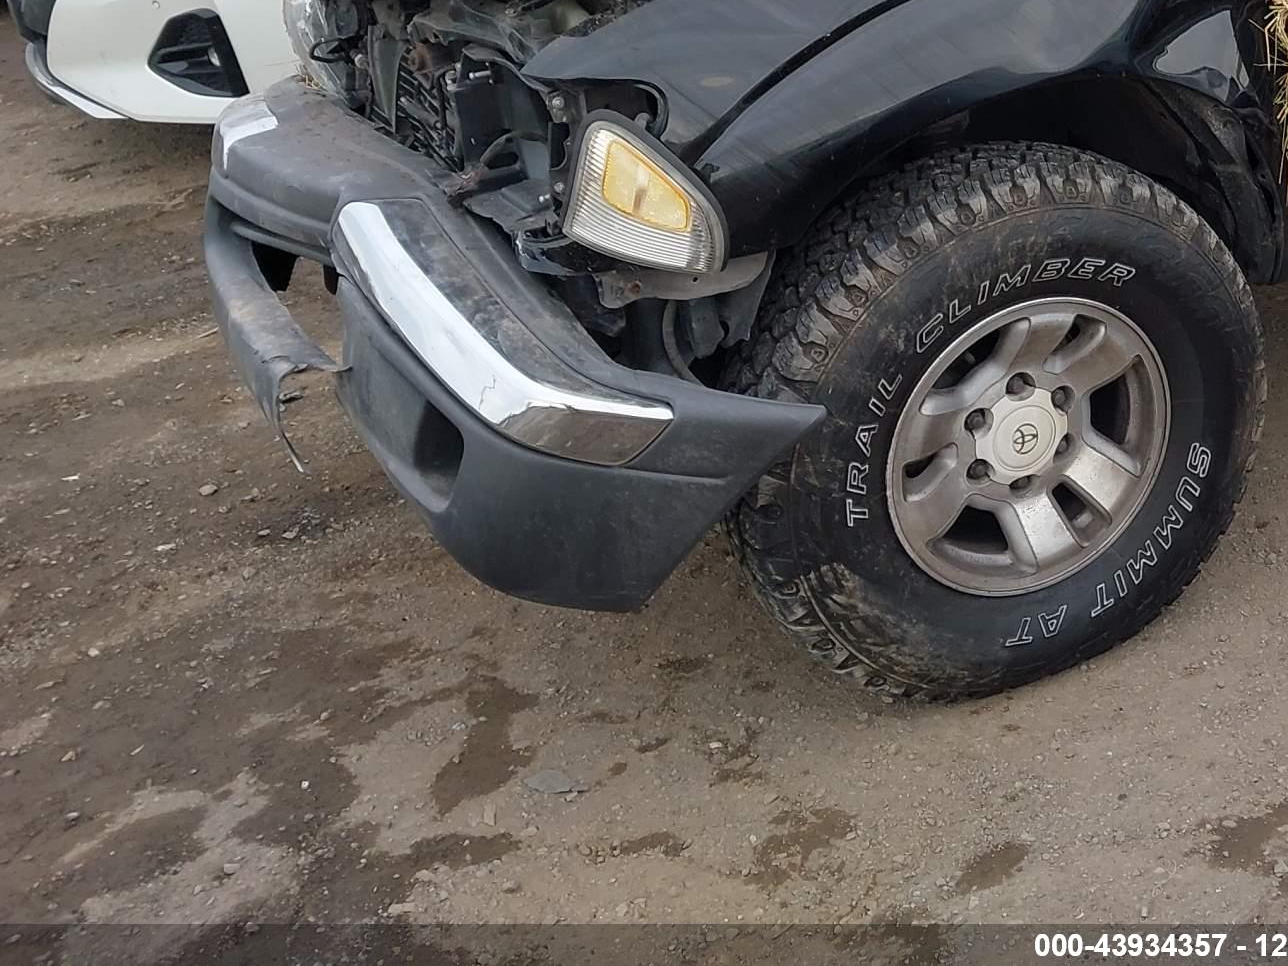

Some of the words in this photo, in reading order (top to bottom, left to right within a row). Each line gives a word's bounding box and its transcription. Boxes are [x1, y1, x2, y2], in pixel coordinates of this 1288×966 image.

[847, 372, 904, 527] TRAIL
[915, 257, 1136, 354] CLIMBER
[1091, 442, 1212, 618] SUMMIT
[1004, 604, 1068, 647] AT
